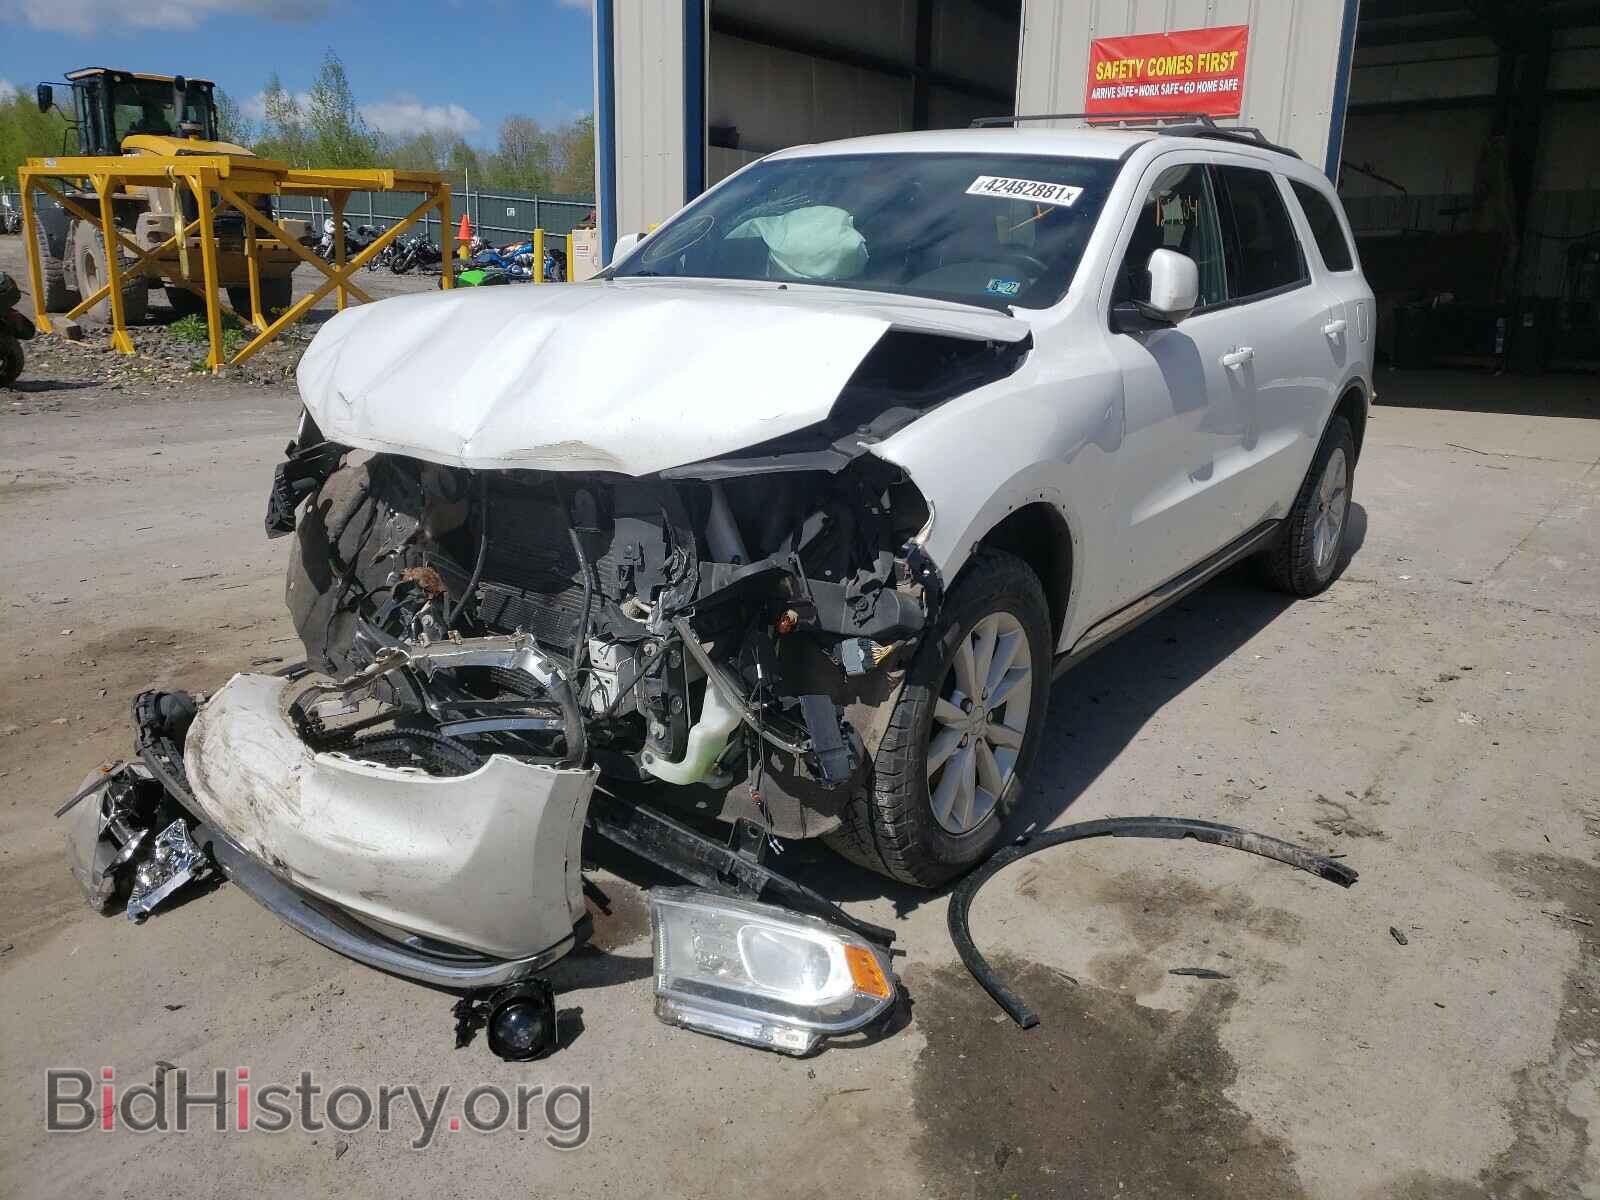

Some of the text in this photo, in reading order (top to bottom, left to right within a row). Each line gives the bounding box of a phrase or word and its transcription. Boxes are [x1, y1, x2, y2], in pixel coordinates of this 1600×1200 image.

[1095, 51, 1239, 80] SAFETY COMES FIRST
[1091, 85, 1116, 99] ARRIVE
[1197, 80, 1219, 93] HOME
[1219, 79, 1238, 91] SAFE
